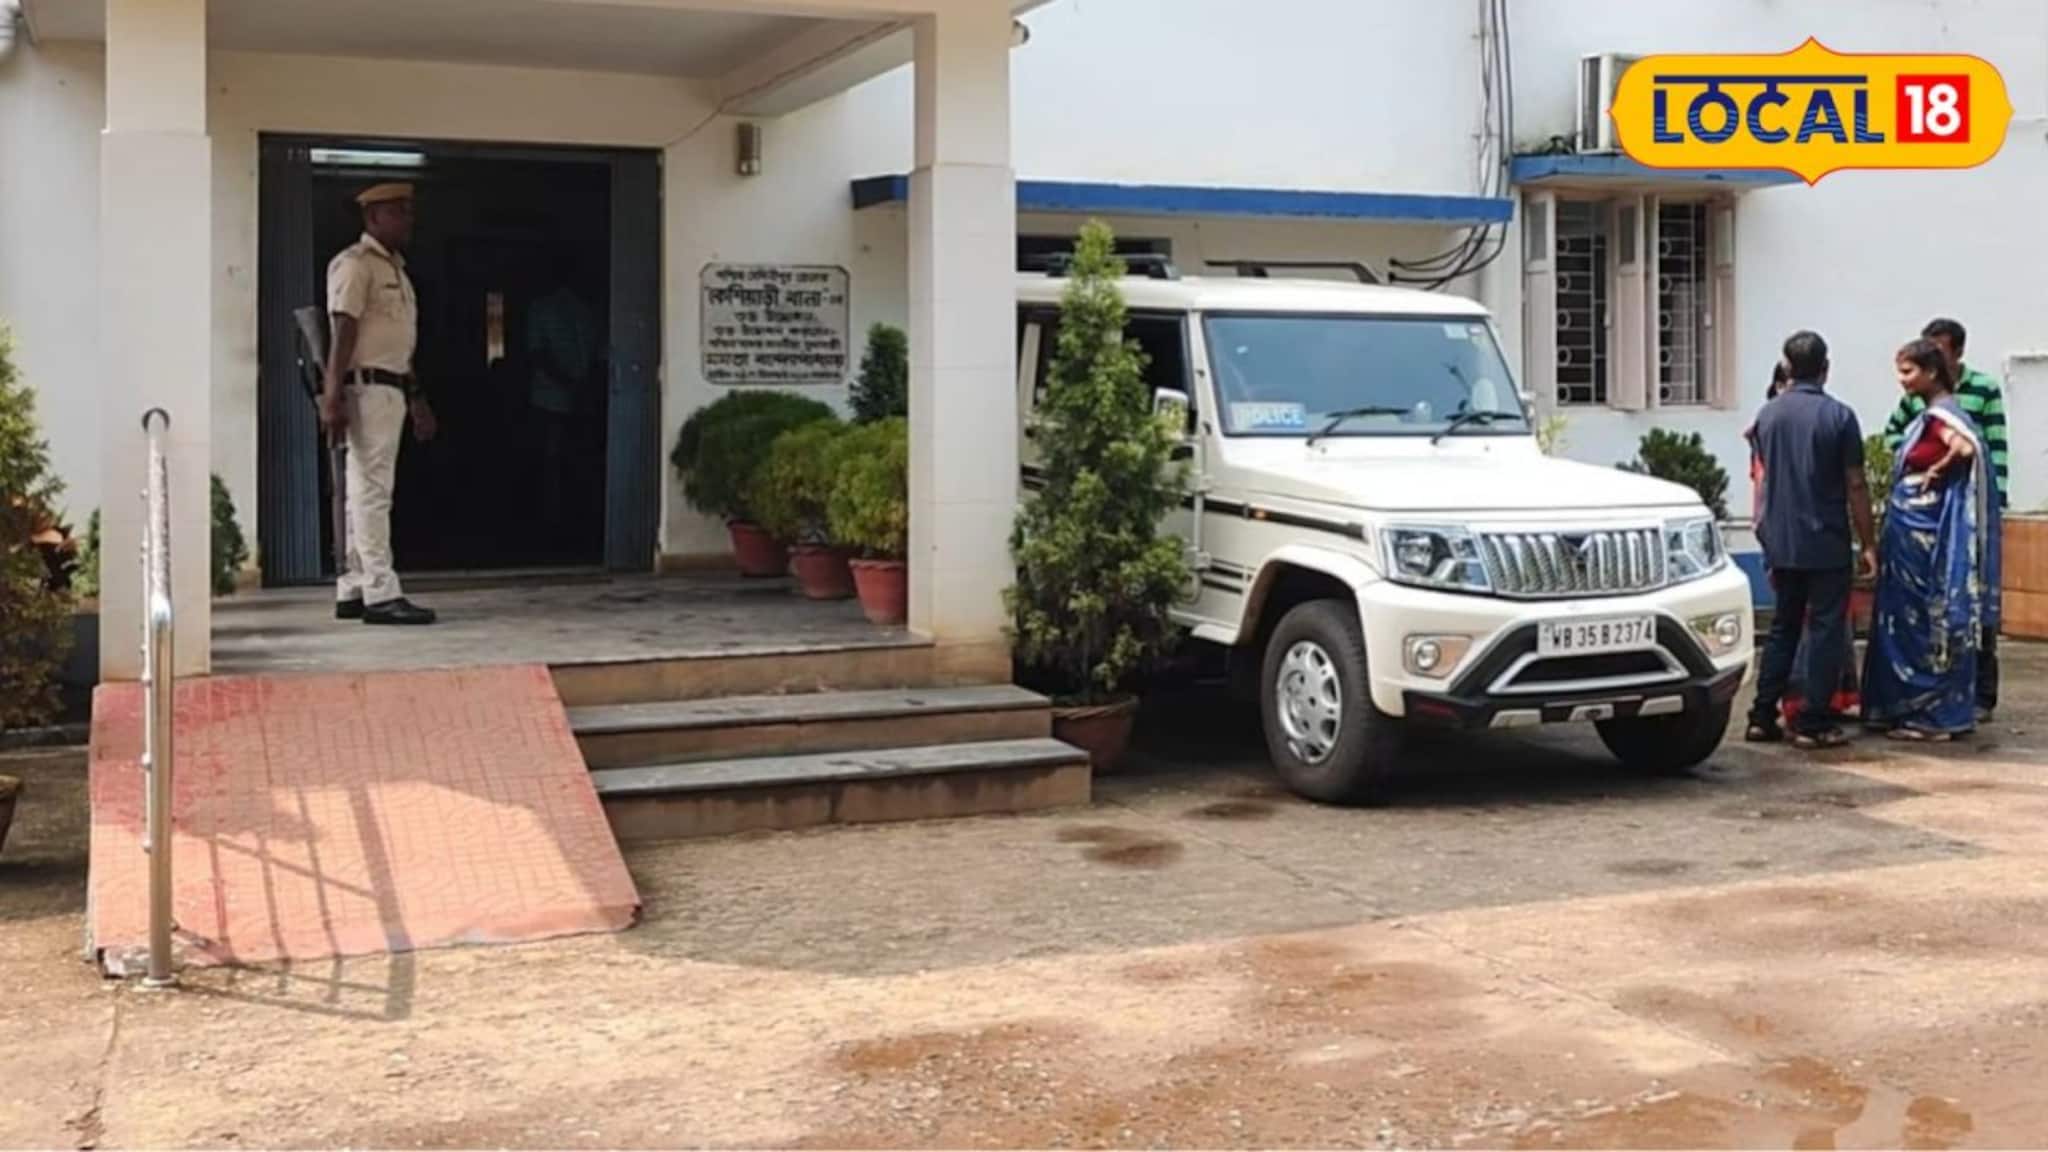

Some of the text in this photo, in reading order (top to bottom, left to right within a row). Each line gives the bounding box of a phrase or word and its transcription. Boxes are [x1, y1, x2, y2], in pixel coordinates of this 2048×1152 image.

[1553, 619, 1653, 649] WB 35 B 2374
